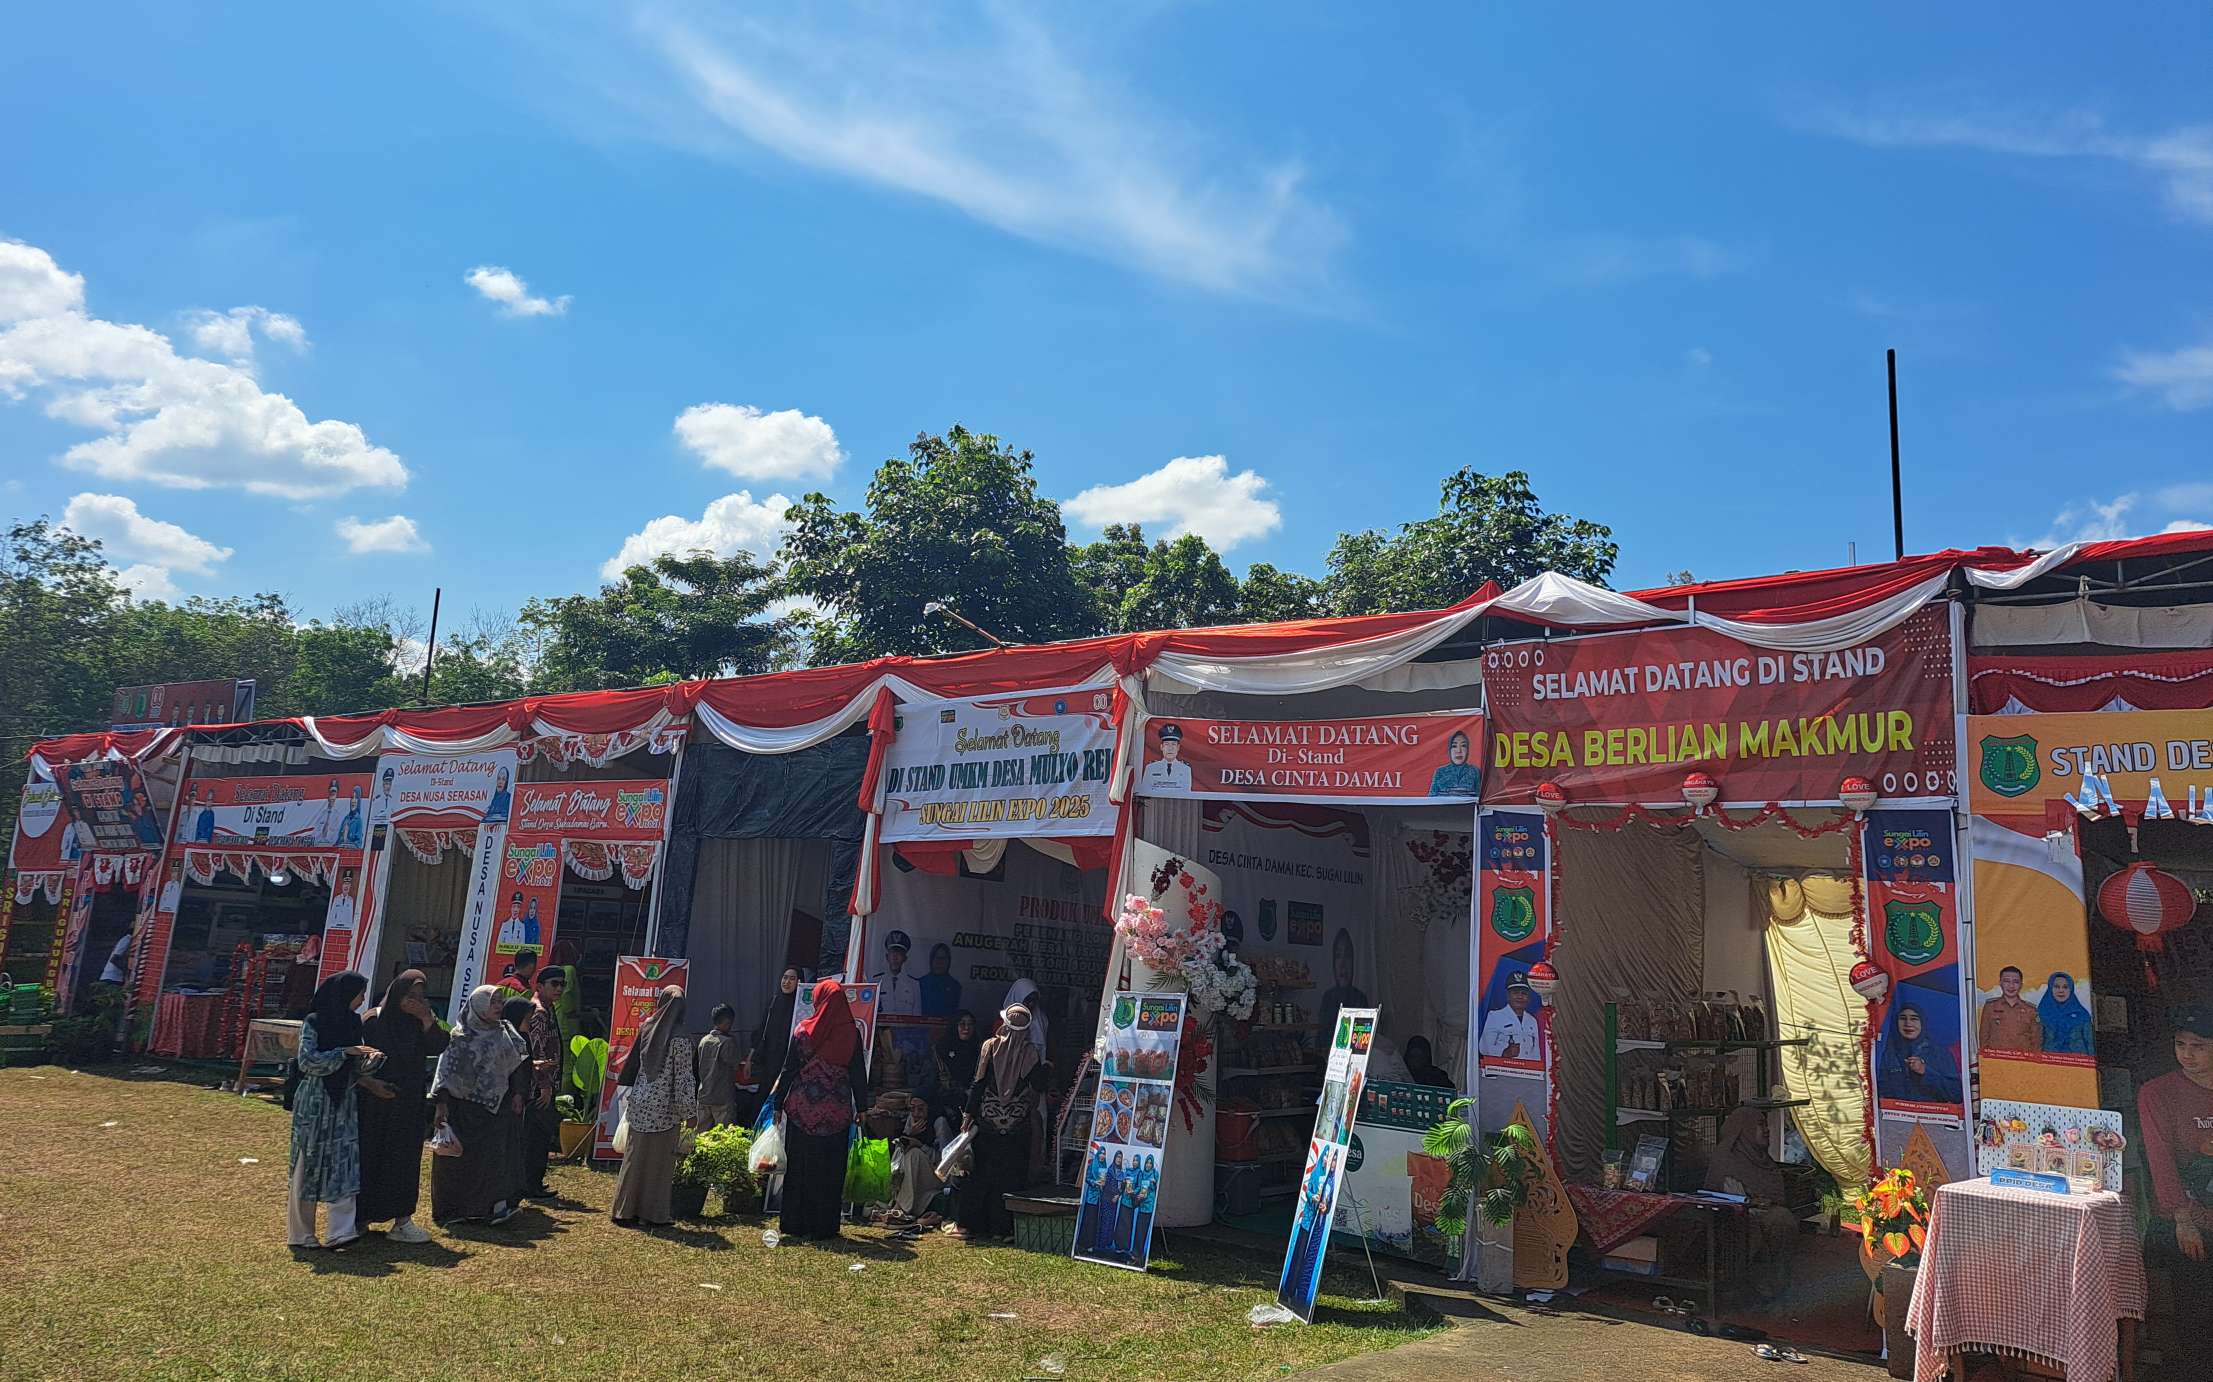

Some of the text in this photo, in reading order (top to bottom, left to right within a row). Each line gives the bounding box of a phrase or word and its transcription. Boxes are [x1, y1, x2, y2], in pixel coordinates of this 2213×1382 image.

[1532, 646, 1886, 700] SELAMAT DATANG DI STAND
[954, 724, 1061, 756] Selamat Datang
[1207, 724, 1420, 746] SELAMAT DATANG
[1494, 709, 1914, 769] DESA BERLIAN MAKMUR
[1297, 748, 1345, 764] Stand
[2050, 740, 2213, 777] STAND DE
[399, 759, 497, 777] Selamat Datang
[886, 748, 1113, 794] DI STAND UMKM DESA MULYO REJ
[1220, 769, 1403, 788] DESA CINTA DAMAI
[1847, 783, 1871, 791] LOVE
[400, 790, 488, 802] DESA NUSA SERASAN
[520, 789, 612, 817] Selamat Datang
[1541, 791, 1560, 799] LOVE
[243, 806, 286, 824] Di Stand
[615, 803, 664, 829] expo
[919, 795, 1091, 825] SUNGAI LILIN EXPO 2025
[1495, 832, 1529, 844] expo
[1883, 837, 1932, 851] expo
[477, 835, 494, 896] DESA
[505, 859, 556, 886] expo
[1208, 849, 1236, 866] DESA
[1237, 854, 1262, 871] CINTA
[1264, 858, 1294, 875] DAMAI
[1316, 866, 1342, 883] SUGAI
[1343, 870, 1365, 886] LILIN
[466, 901, 483, 962] NUSA
[953, 931, 1028, 953] ANUGERAH
[1855, 966, 1878, 979] LOVE
[622, 985, 664, 998] Selamat Da
[1142, 1002, 1178, 1012] Sungai Lilin
[1141, 1011, 1178, 1027] expo
[1352, 1032, 1371, 1049] expo
